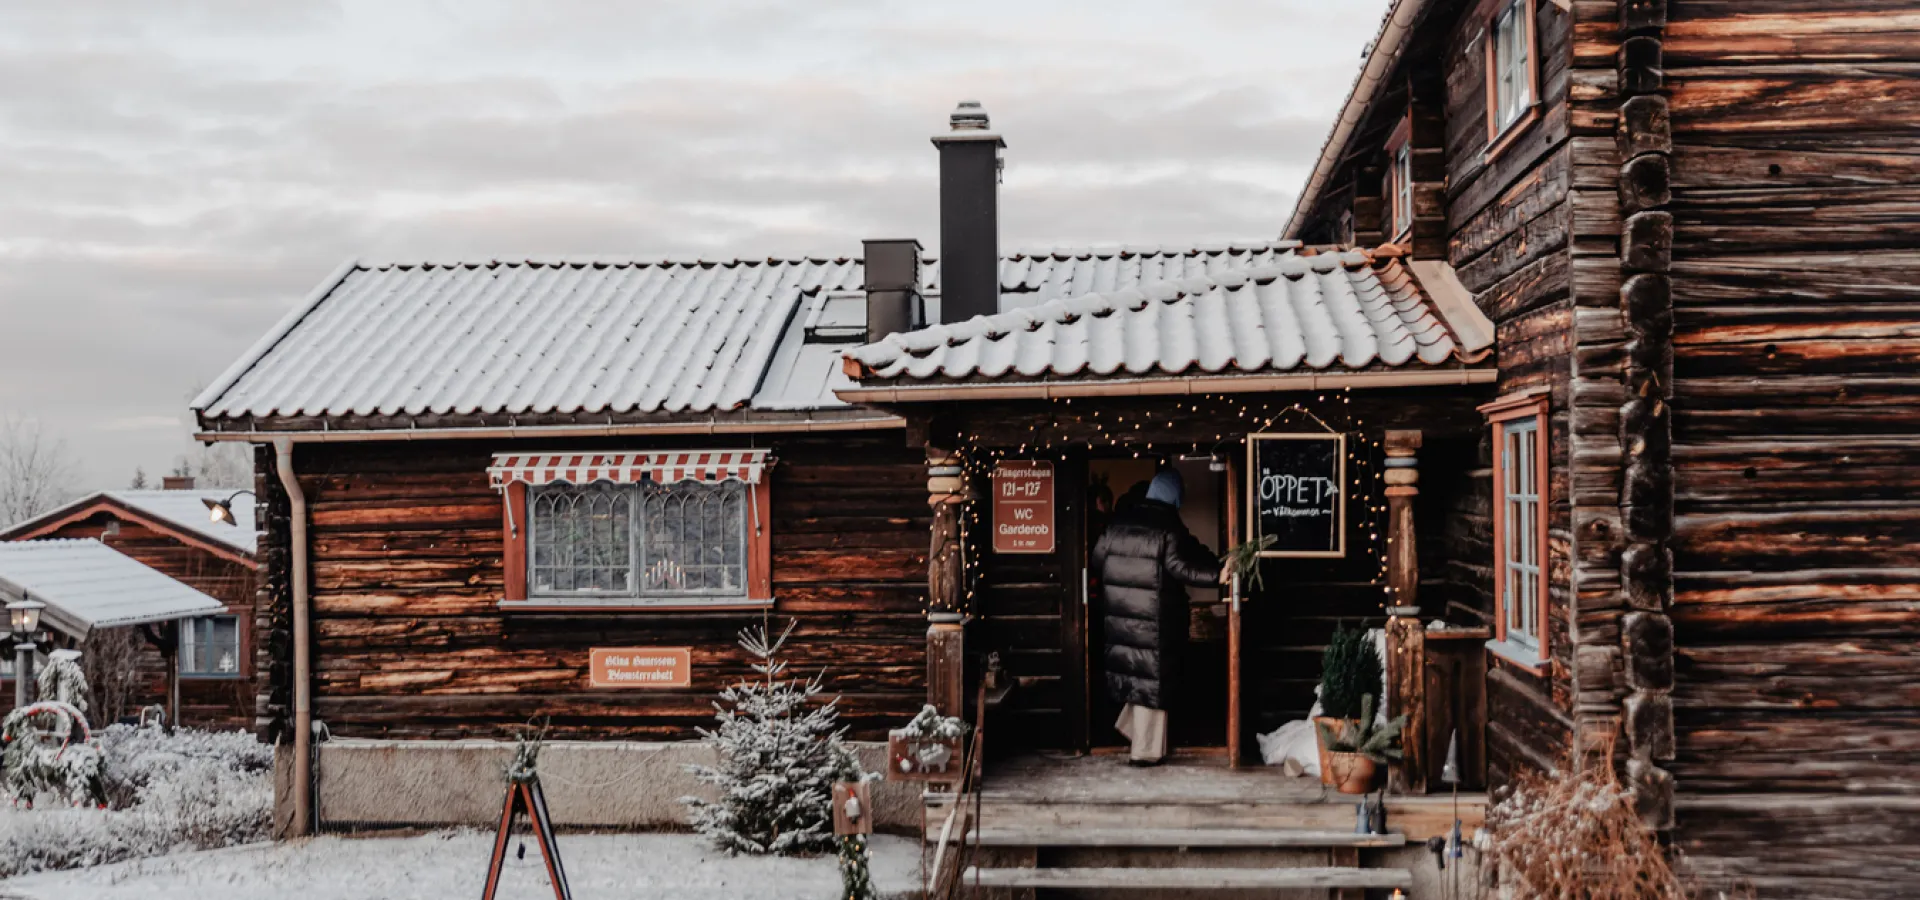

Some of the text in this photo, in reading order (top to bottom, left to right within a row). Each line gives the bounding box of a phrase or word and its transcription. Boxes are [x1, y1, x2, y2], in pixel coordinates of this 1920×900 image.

[1260, 467, 1328, 504] ÖPPET
[1013, 508, 1033, 520] WC
[1000, 523, 1049, 535] Garderob
